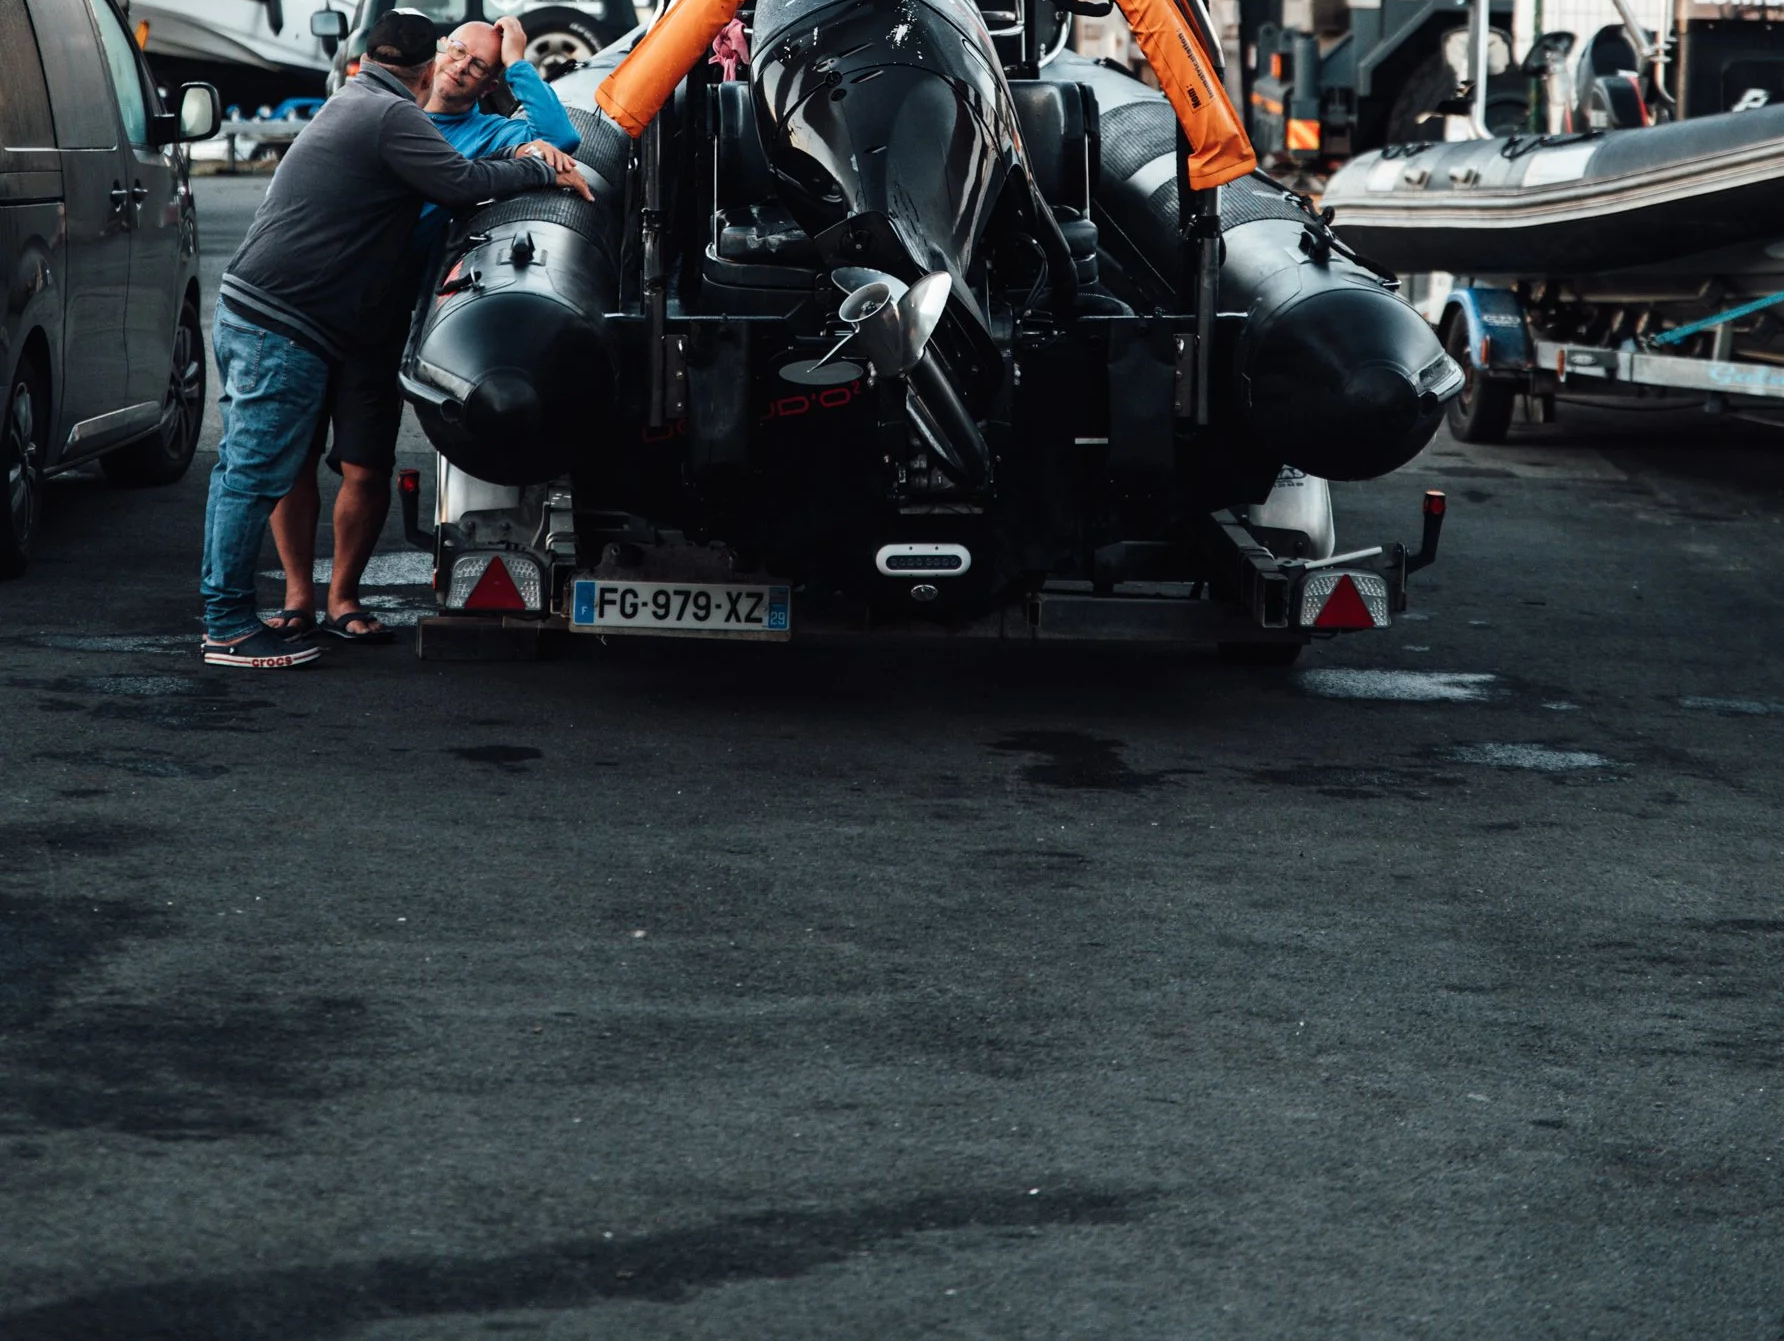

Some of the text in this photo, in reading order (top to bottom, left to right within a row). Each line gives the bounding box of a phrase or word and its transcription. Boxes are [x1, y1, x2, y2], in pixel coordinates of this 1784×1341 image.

[581, 606, 588, 615] F
[598, 587, 765, 623] FG-979-XZ
[770, 611, 785, 626] 29
[251, 656, 294, 667] crocs
